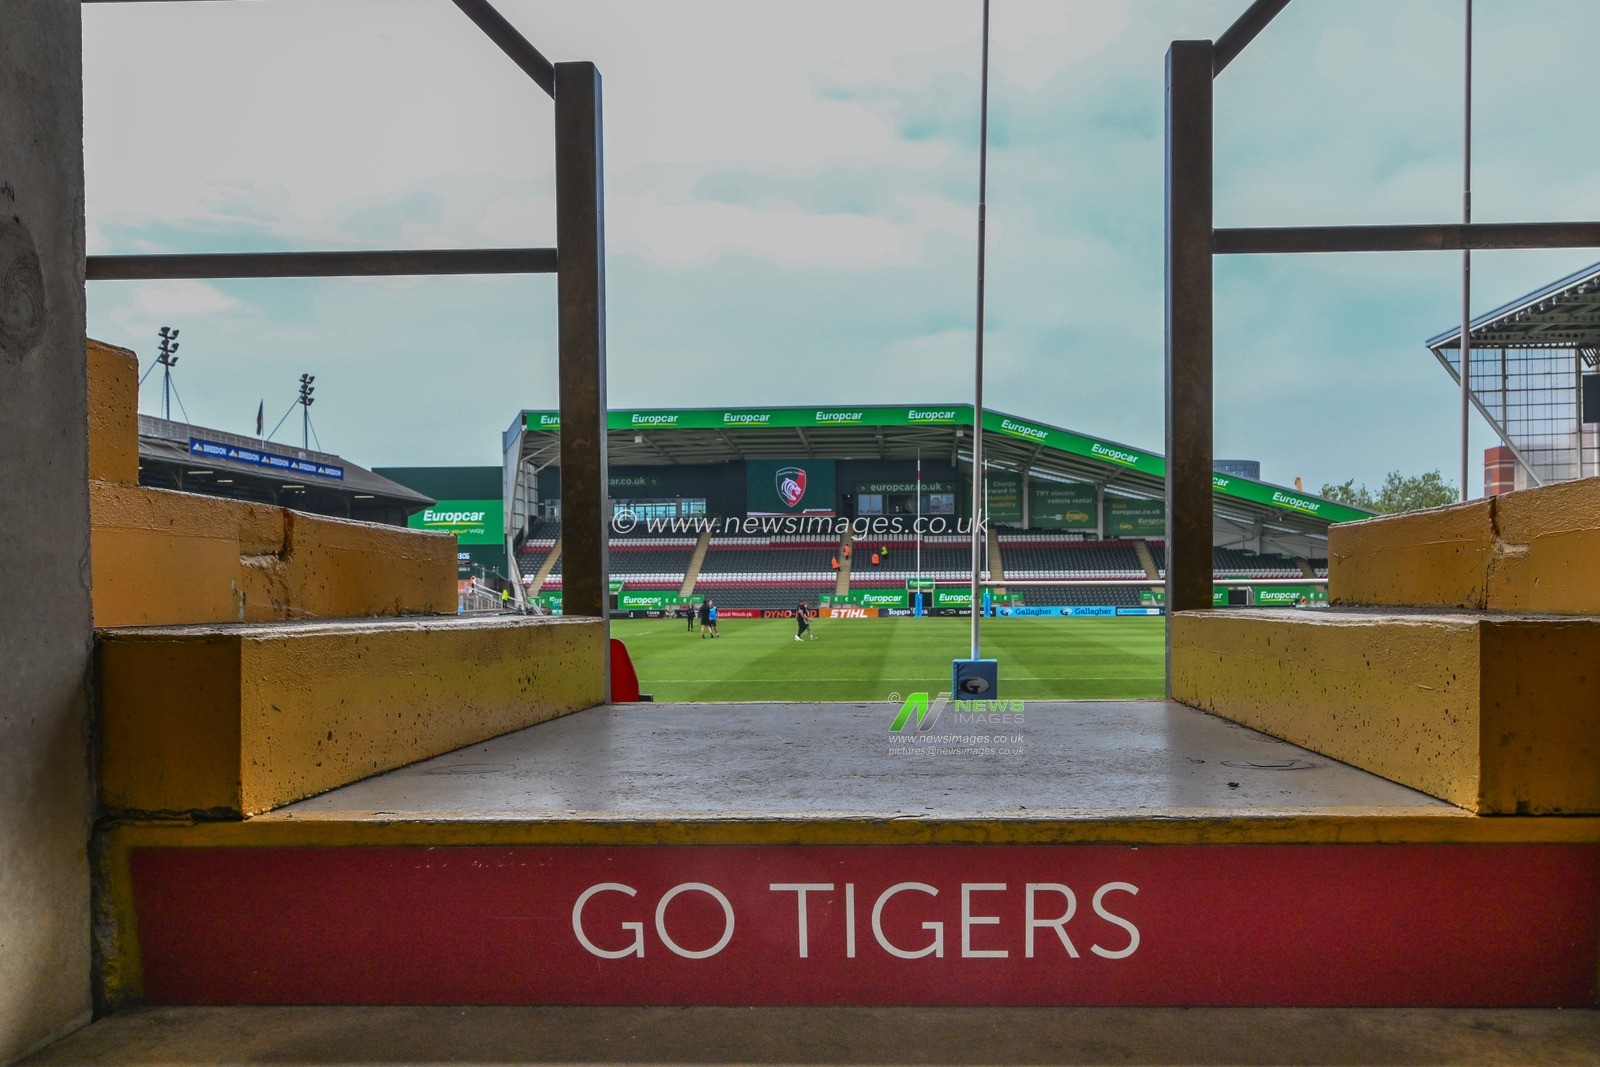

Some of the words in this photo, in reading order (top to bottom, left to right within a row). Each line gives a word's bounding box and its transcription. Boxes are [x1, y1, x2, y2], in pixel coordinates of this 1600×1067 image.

[632, 414, 678, 426] Europcar
[724, 413, 770, 424] Europcar
[816, 412, 862, 423] Europcar
[908, 410, 955, 421] Europcar
[204, 444, 226, 455] BREEDON
[239, 451, 260, 461] BREEDON
[270, 457, 289, 466] BREEDON
[299, 463, 316, 472] BREEDON
[325, 468, 341, 476] BREEDON
[1001, 420, 1048, 438] Europcar
[1092, 444, 1138, 463] Europcar
[1272, 492, 1320, 511] Europcar
[608, 477, 645, 485] ar.co.uk
[423, 510, 485, 525] Europcar
[623, 596, 661, 604] Europcar
[864, 594, 902, 602] Europcar
[1260, 591, 1300, 600] Europcar
[830, 609, 868, 617] STIHL
[572, 882, 735, 958] GO
[770, 882, 1140, 958] TIGERS
